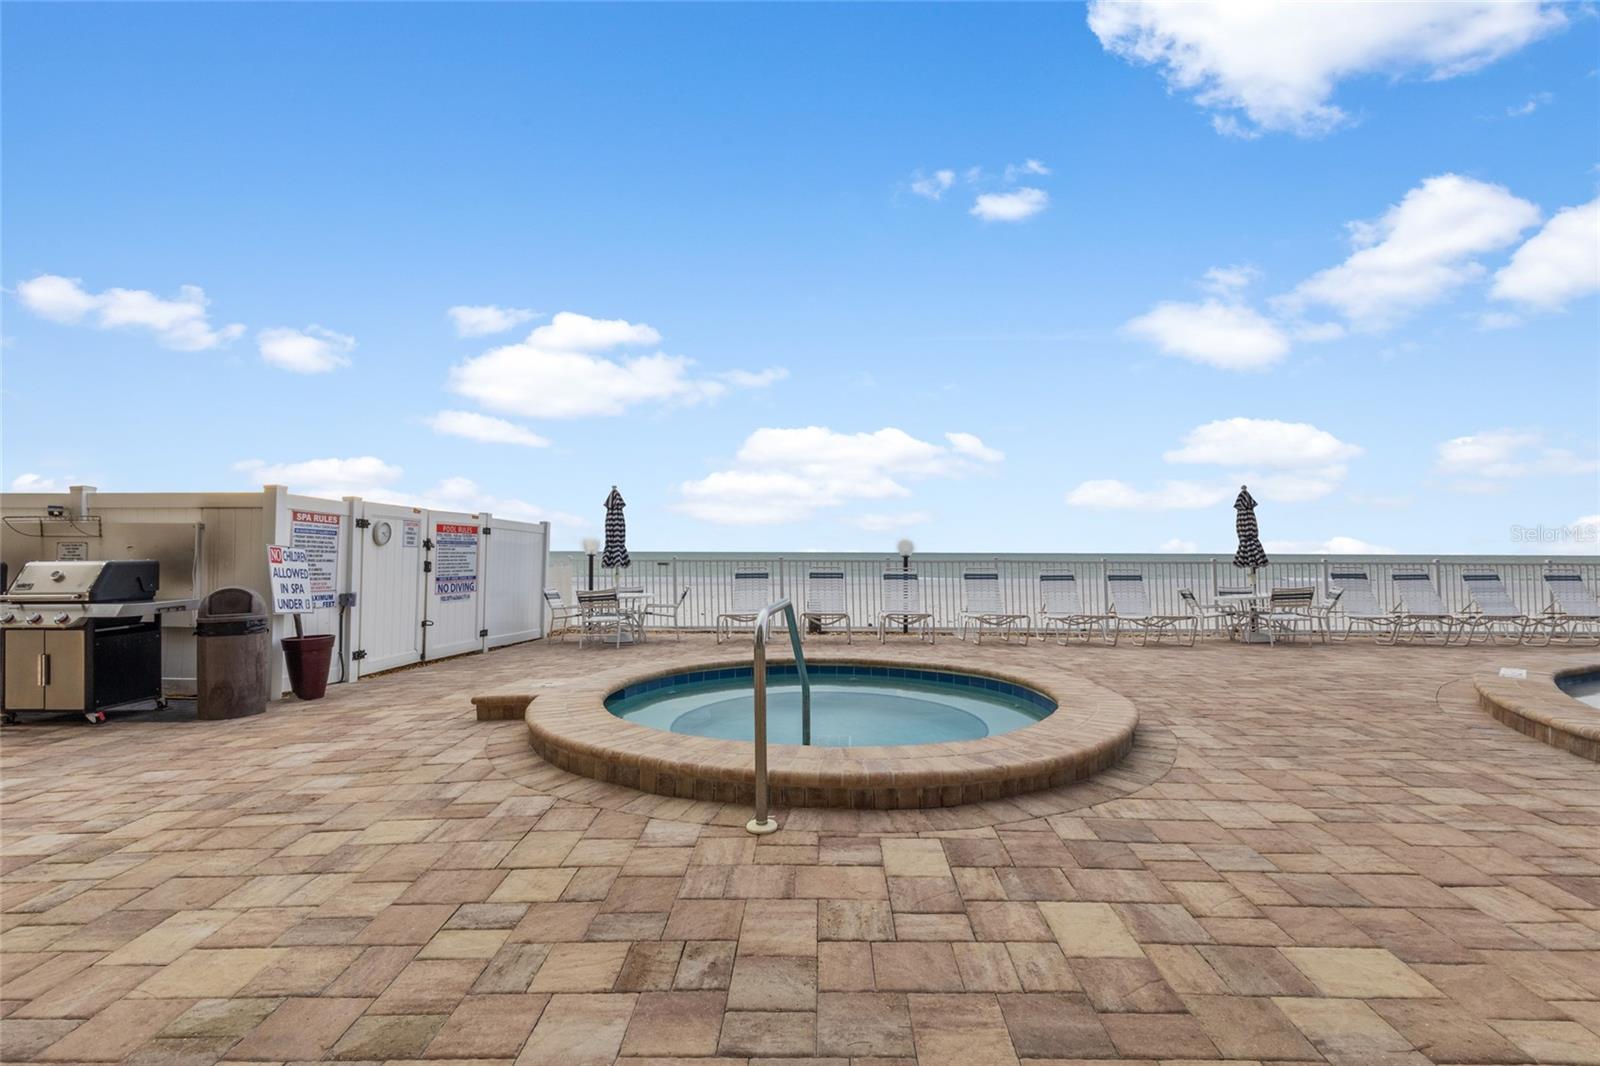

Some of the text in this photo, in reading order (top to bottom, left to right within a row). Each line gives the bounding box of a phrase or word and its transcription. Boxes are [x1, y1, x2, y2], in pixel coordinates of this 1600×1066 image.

[296, 512, 338, 524] SPA RULES
[442, 525, 473, 534] POOL RULES
[271, 548, 307, 562] NO CHILDREN
[273, 567, 309, 579] ALLOWED
[280, 583, 289, 594] IN
[291, 583, 305, 594] SPA
[438, 582, 475, 593] NO DIVING
[277, 599, 303, 610] UNDER
